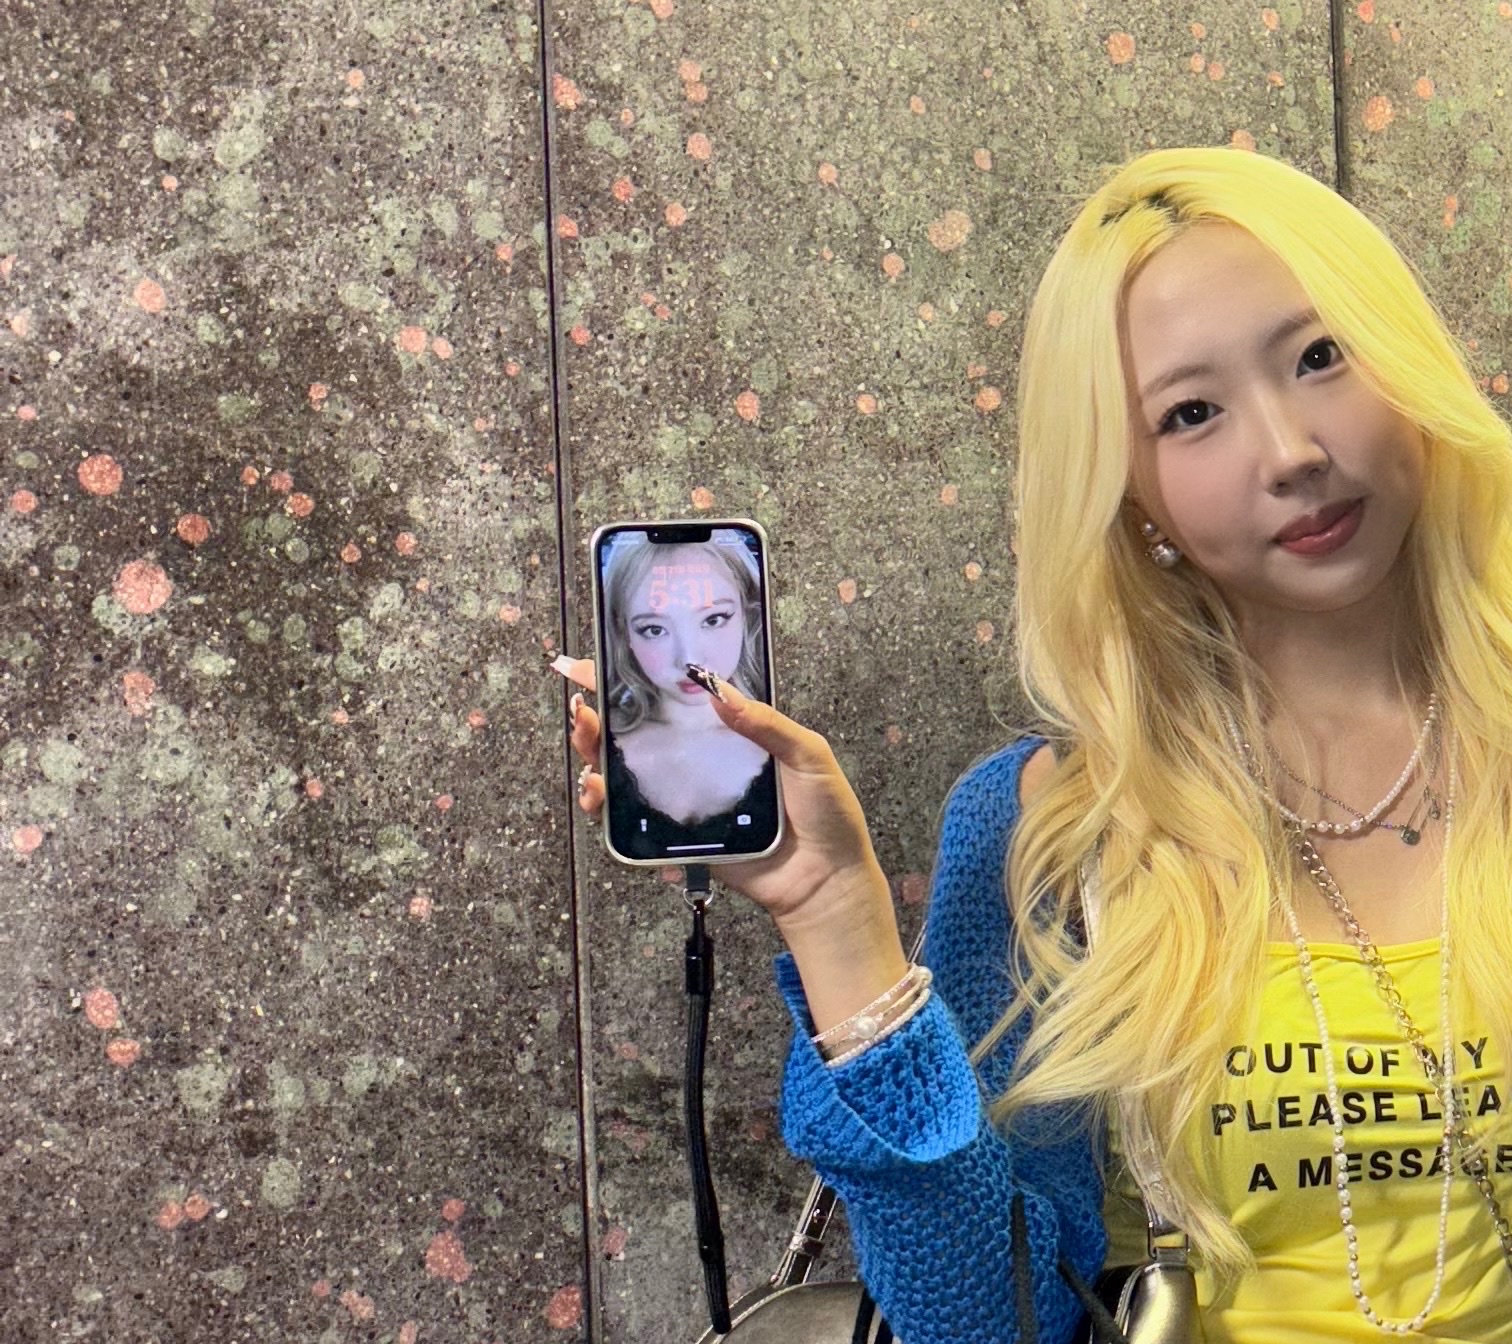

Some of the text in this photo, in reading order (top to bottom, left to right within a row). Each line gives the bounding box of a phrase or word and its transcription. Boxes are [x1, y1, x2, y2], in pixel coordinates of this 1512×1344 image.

[1225, 1042, 1323, 1077] OUT
[1346, 1046, 1400, 1077] OF
[1211, 1091, 1397, 1136] PLEASE
[1248, 1163, 1278, 1193] A
